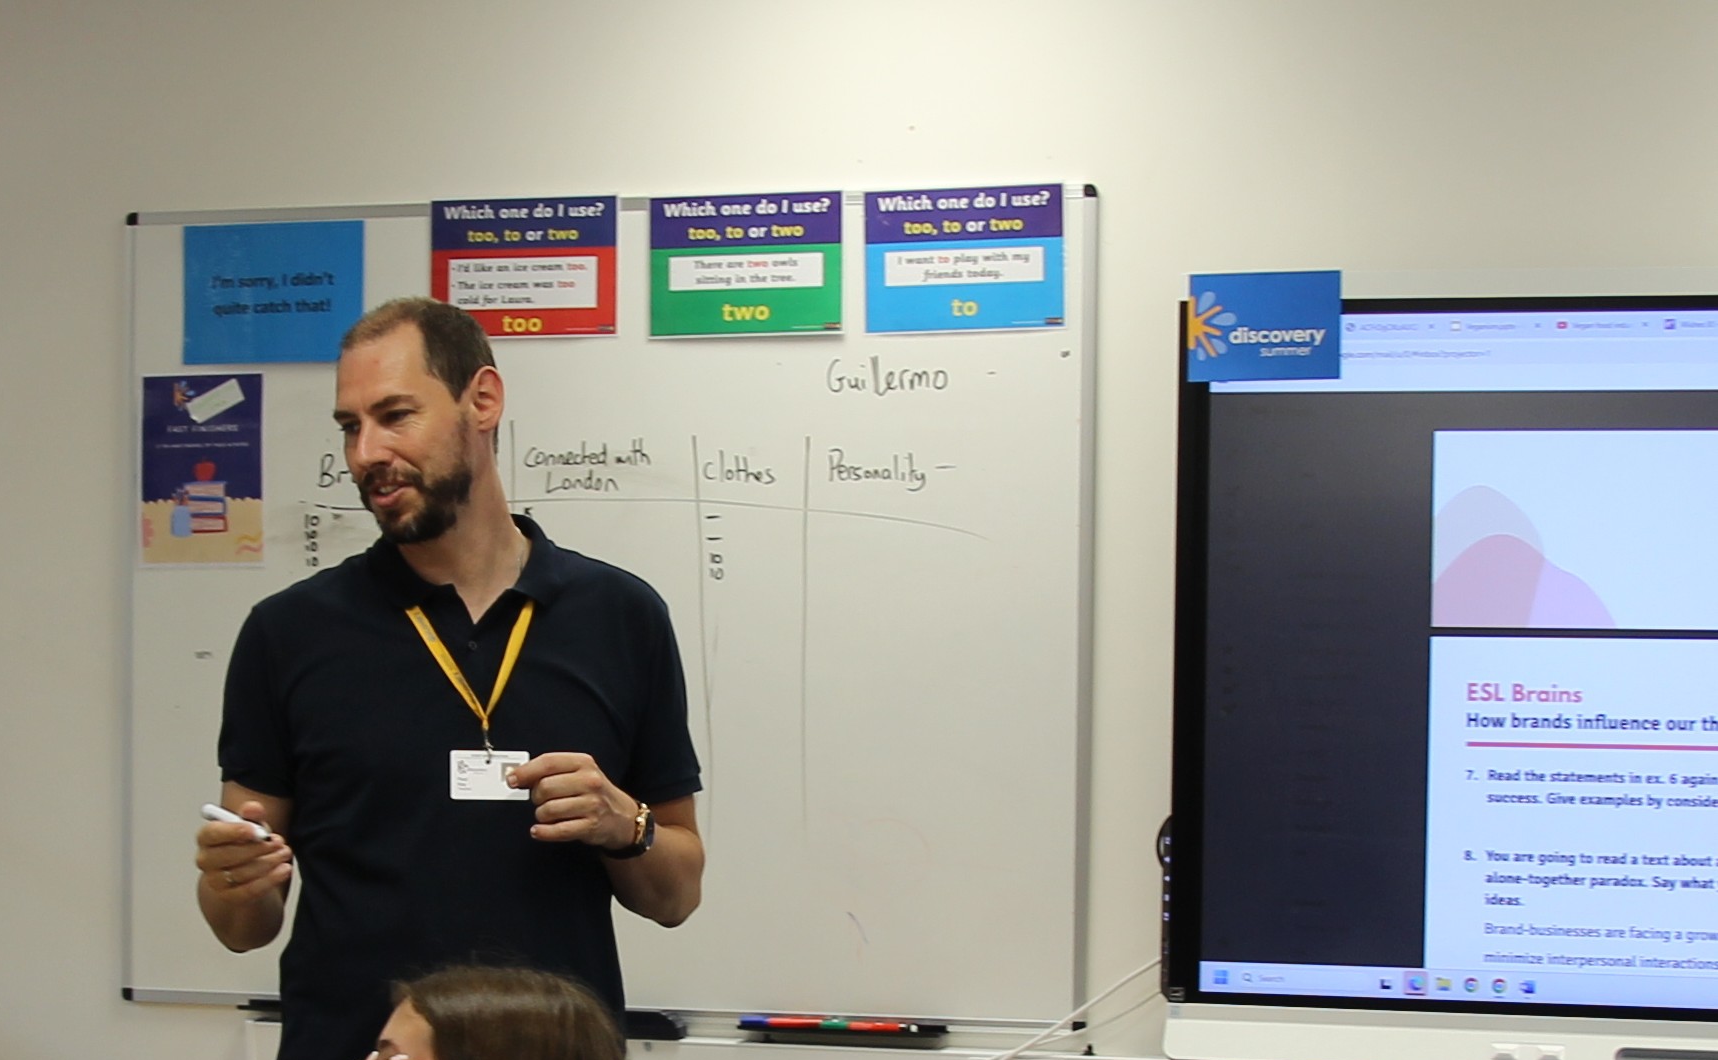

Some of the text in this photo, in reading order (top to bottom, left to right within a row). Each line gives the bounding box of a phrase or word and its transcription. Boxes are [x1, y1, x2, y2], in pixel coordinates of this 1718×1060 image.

[663, 197, 831, 218] Which one do I use?
[877, 190, 1050, 212] Which one do I use?
[444, 202, 605, 220] Which one do I use?
[467, 228, 579, 243] too, to or two
[688, 225, 805, 241] too, to or two
[903, 218, 1024, 236] too, to or two
[474, 263, 493, 272] like
[514, 263, 527, 272] ice
[694, 260, 724, 269] There
[747, 260, 768, 268] two
[772, 258, 798, 267] owls
[905, 256, 934, 264] want
[938, 255, 951, 264] to
[953, 253, 979, 265] play
[982, 252, 1009, 262] with
[1012, 253, 1030, 263] my
[212, 275, 235, 289] I'm
[238, 276, 278, 290] sorry,
[290, 272, 335, 286] didn't
[696, 275, 732, 286] sitting
[735, 274, 746, 283] in
[750, 274, 767, 283] the
[922, 269, 963, 281] friends
[458, 280, 576, 290] The ice cream was too
[213, 299, 331, 318] quite catch that!
[722, 303, 770, 321] two
[951, 299, 979, 317] to
[502, 315, 543, 332] too
[1228, 327, 1326, 346] discovery
[1259, 346, 1312, 357] summer
[523, 437, 651, 468] Connected with
[703, 449, 776, 485] Clothes
[828, 448, 926, 492] Personality
[546, 469, 619, 493] London
[1467, 682, 1583, 703] ESL Brains
[1466, 712, 1507, 728] How
[1510, 712, 1572, 729] brands
[1577, 713, 1661, 731] influence
[1666, 719, 1697, 731] our
[1465, 770, 1479, 781] 7.
[1487, 770, 1521, 782] Read
[1524, 770, 1545, 782] the
[1549, 771, 1625, 784] statements
[1629, 771, 1642, 784] in
[1645, 774, 1665, 784] ex.
[1669, 773, 1678, 784] 6
[1486, 793, 1542, 804] success.
[1546, 792, 1577, 805] Give
[1579, 794, 1643, 809] examples
[1647, 795, 1662, 809] by
[1464, 850, 1477, 861] 8.
[1485, 850, 1510, 862] You
[1513, 853, 1534, 862] are
[1537, 851, 1576, 866] going
[1579, 853, 1593, 864] to
[1597, 853, 1627, 865] read
[1631, 856, 1638, 865] a
[1642, 855, 1670, 866] text
[1673, 854, 1713, 867] about
[1485, 872, 1714, 891] alone-together paradox. Say what
[1484, 894, 1524, 906] ideas.
[1484, 923, 1601, 938] Brand-businesses
[1604, 928, 1626, 938] are
[1629, 926, 1671, 942] facing
[1674, 931, 1683, 940] a
[1484, 952, 1544, 964] minimize
[1547, 953, 1637, 968] interpersonal
